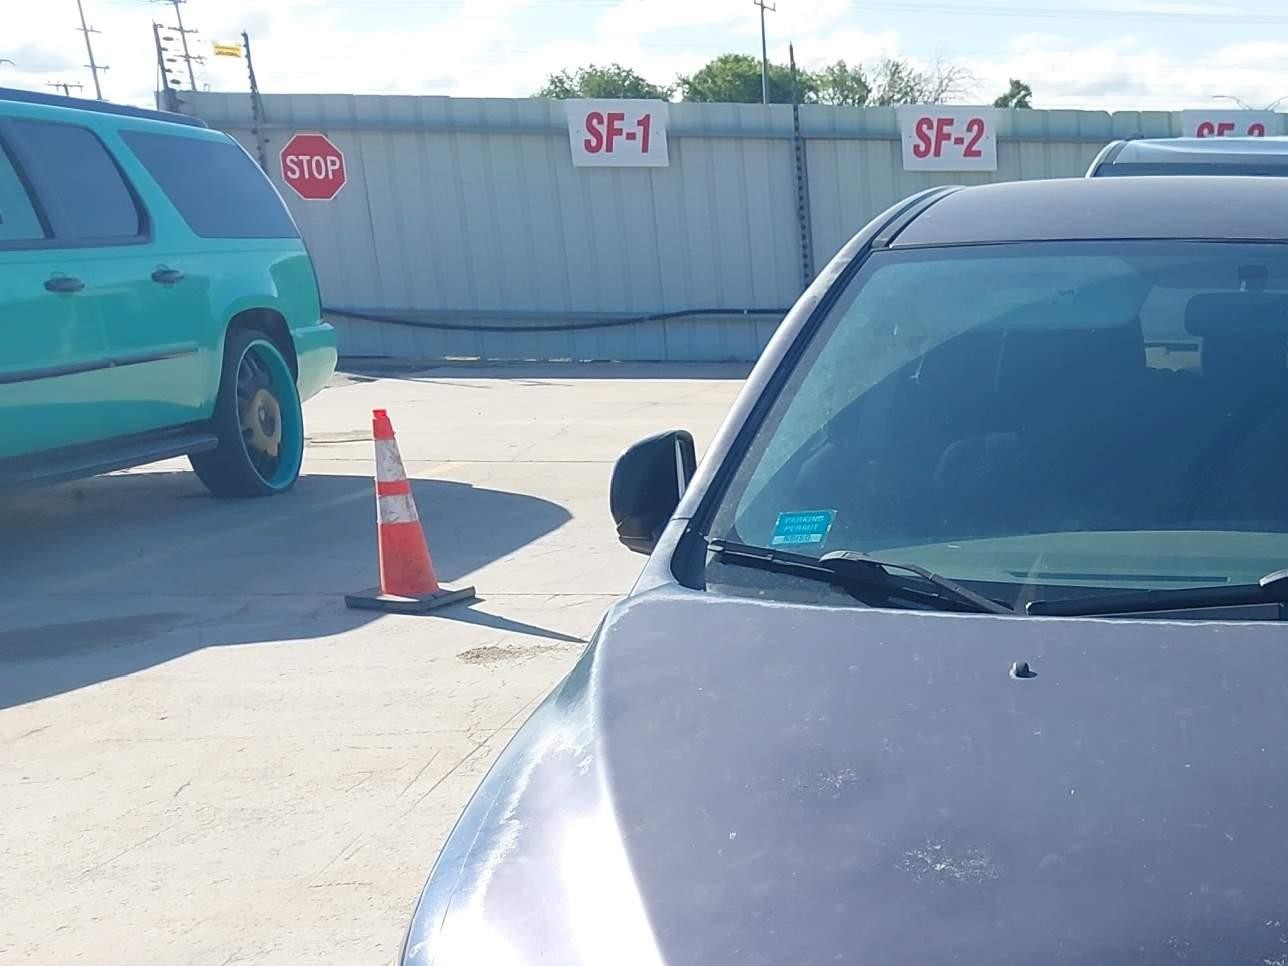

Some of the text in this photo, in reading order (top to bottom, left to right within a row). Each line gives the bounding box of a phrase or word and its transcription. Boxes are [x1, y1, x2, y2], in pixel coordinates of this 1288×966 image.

[584, 111, 651, 154] SF-1
[913, 117, 985, 158] SF-2
[286, 155, 340, 179] STOP
